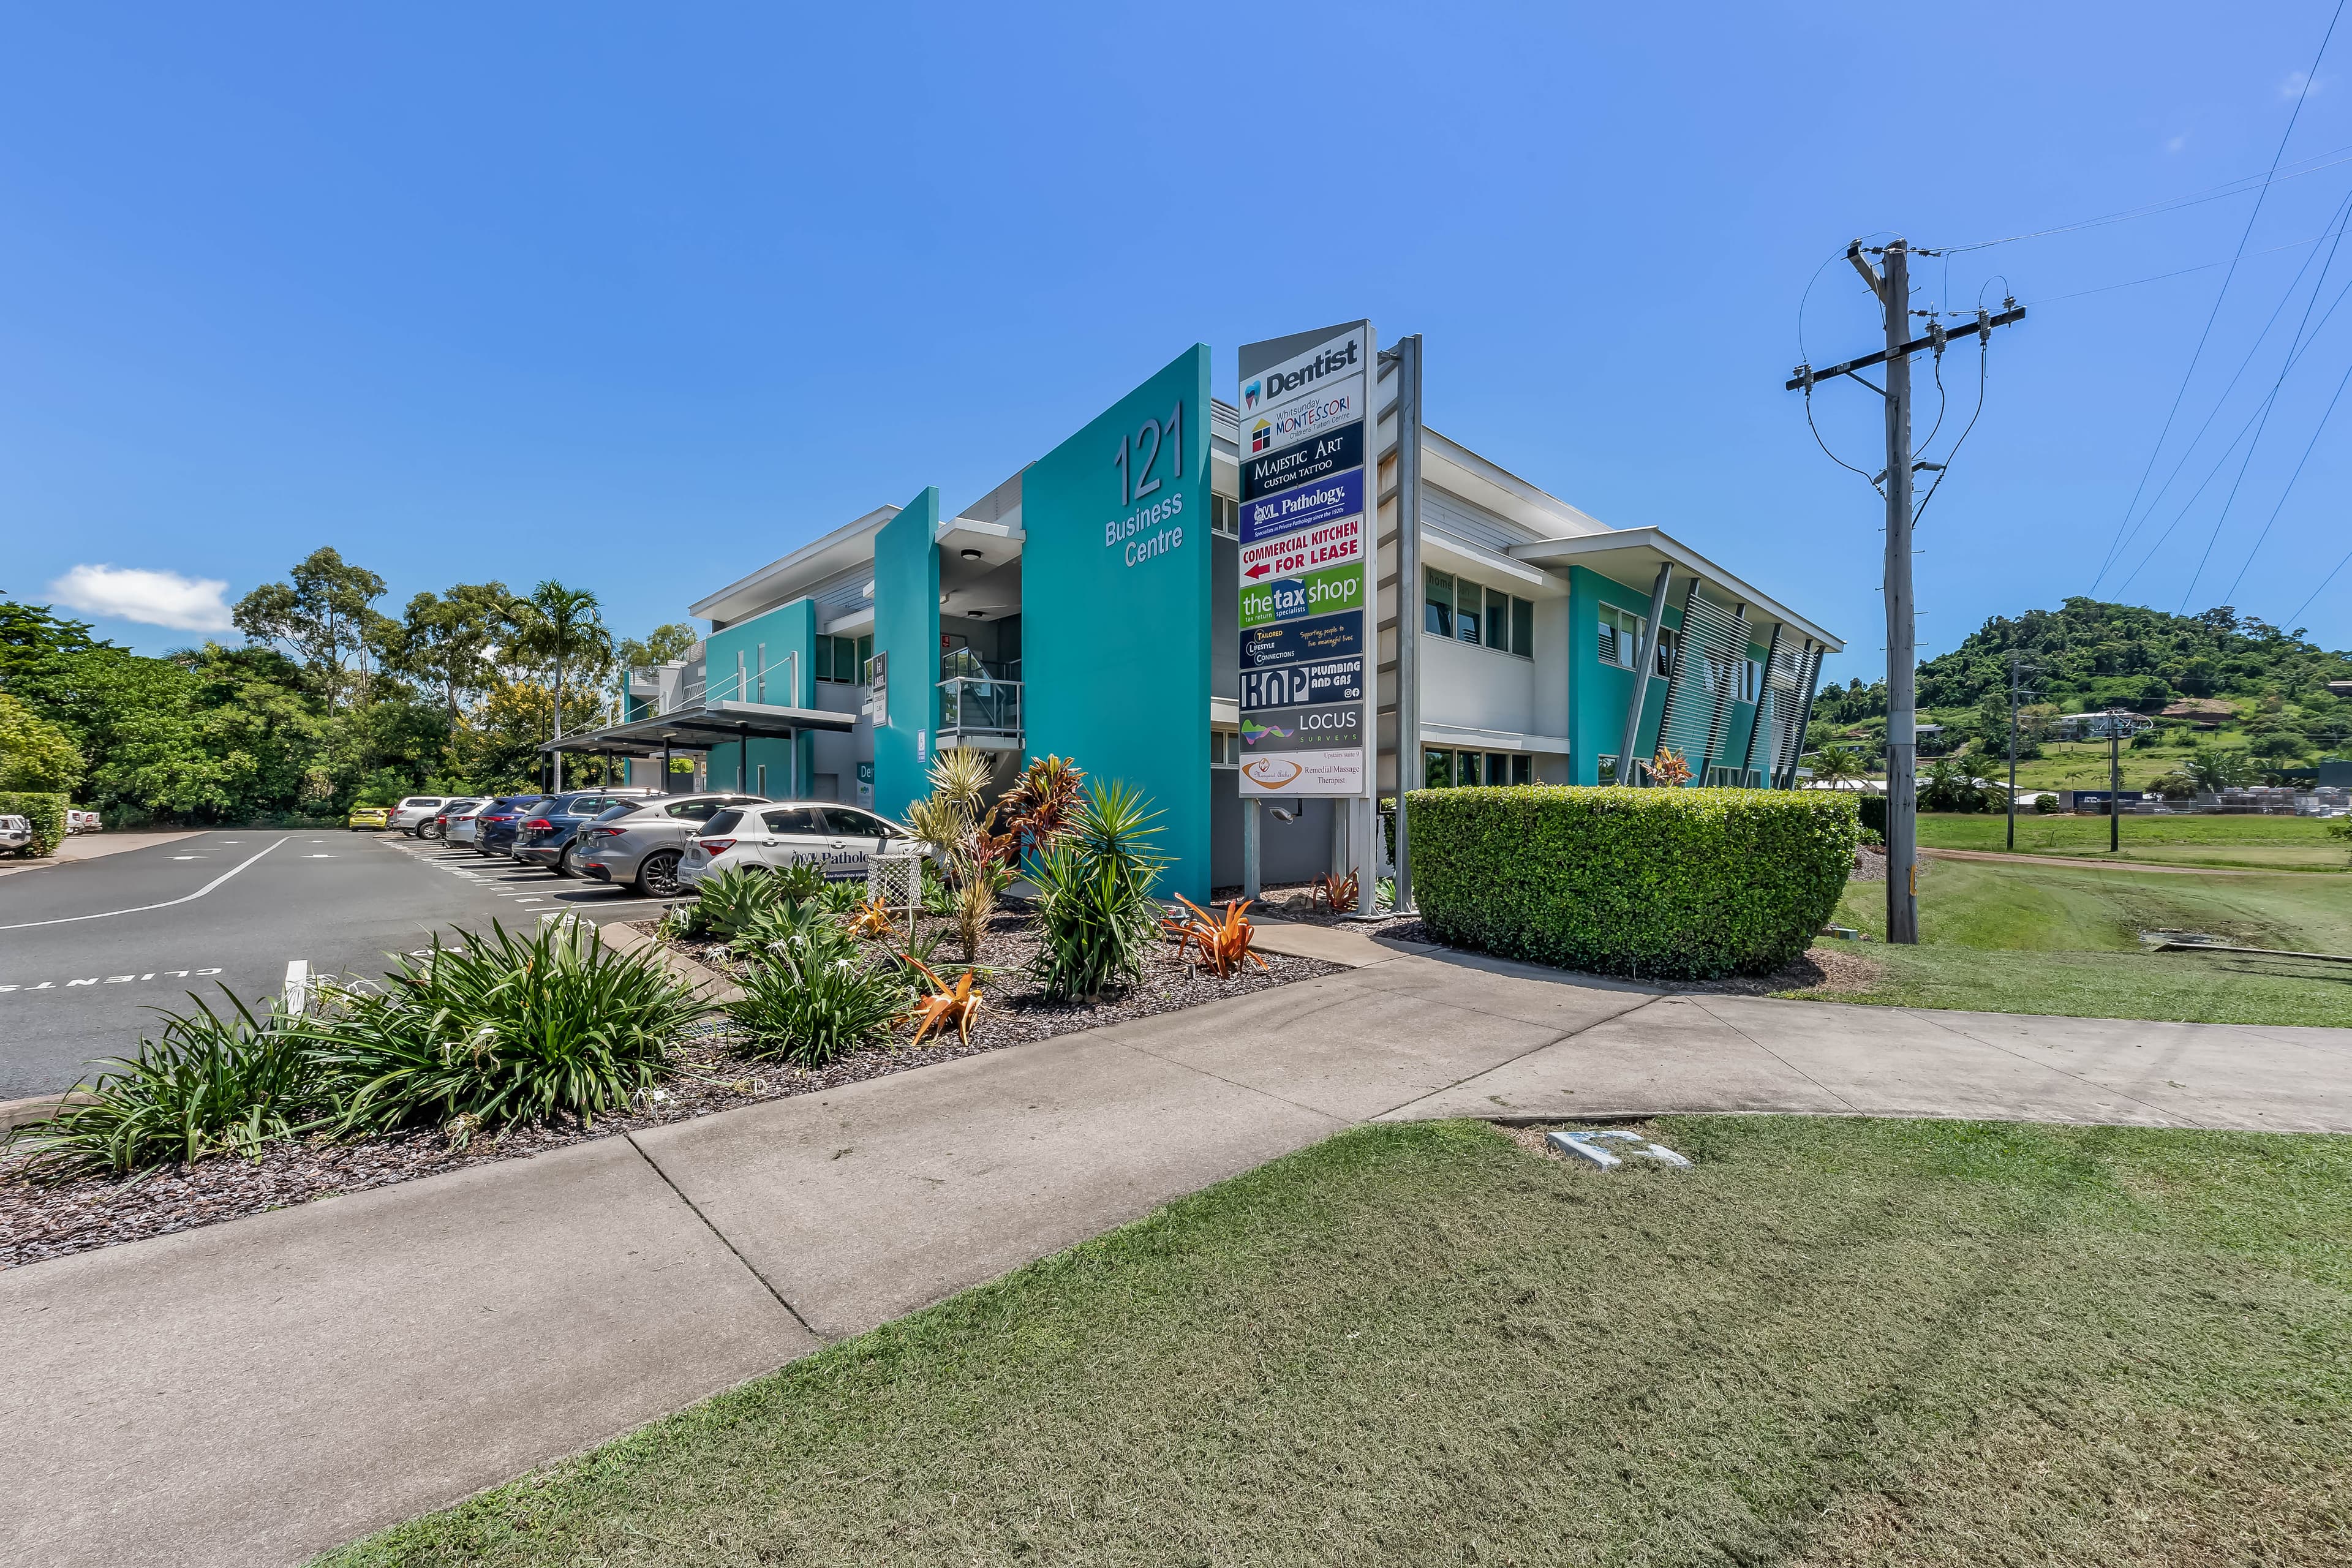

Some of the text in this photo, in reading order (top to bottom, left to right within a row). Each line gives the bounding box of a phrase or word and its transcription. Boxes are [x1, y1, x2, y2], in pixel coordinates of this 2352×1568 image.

[1267, 340, 1357, 400] Dentist
[1276, 398, 1320, 421] Whitsunday
[1276, 396, 1349, 435] MONTESSORI
[1289, 412, 1350, 439] Childrens Tuition Centre
[1113, 400, 1182, 506] 121
[1264, 459, 1333, 489] CUSTOM TATTOO
[1106, 492, 1183, 547] Business
[1254, 528, 1275, 538] Specialists
[1278, 522, 1292, 530] Private
[1292, 516, 1313, 527] Pathology
[1125, 526, 1183, 568] Centre
[1243, 521, 1359, 564] COMMERCIAL KITCHEN
[1275, 539, 1358, 574] FOR LEASE
[1276, 606, 1306, 617] specialists
[1257, 630, 1283, 641] TAILORED
[1300, 628, 1324, 640] Supporting
[1324, 626, 1338, 636] people
[1317, 635, 1341, 647] meaningful
[1249, 642, 1275, 653] LIFESTYLE
[1256, 650, 1295, 663] CONNECTIONS
[1311, 661, 1360, 677] PLUMBING
[1311, 674, 1352, 688] AND GAS
[1300, 711, 1357, 731] LOCUS
[1300, 734, 1357, 743] SURVEYS
[1333, 766, 1360, 774] Massage
[1317, 777, 1346, 785] Therapist
[821, 850, 869, 864] Patholo
